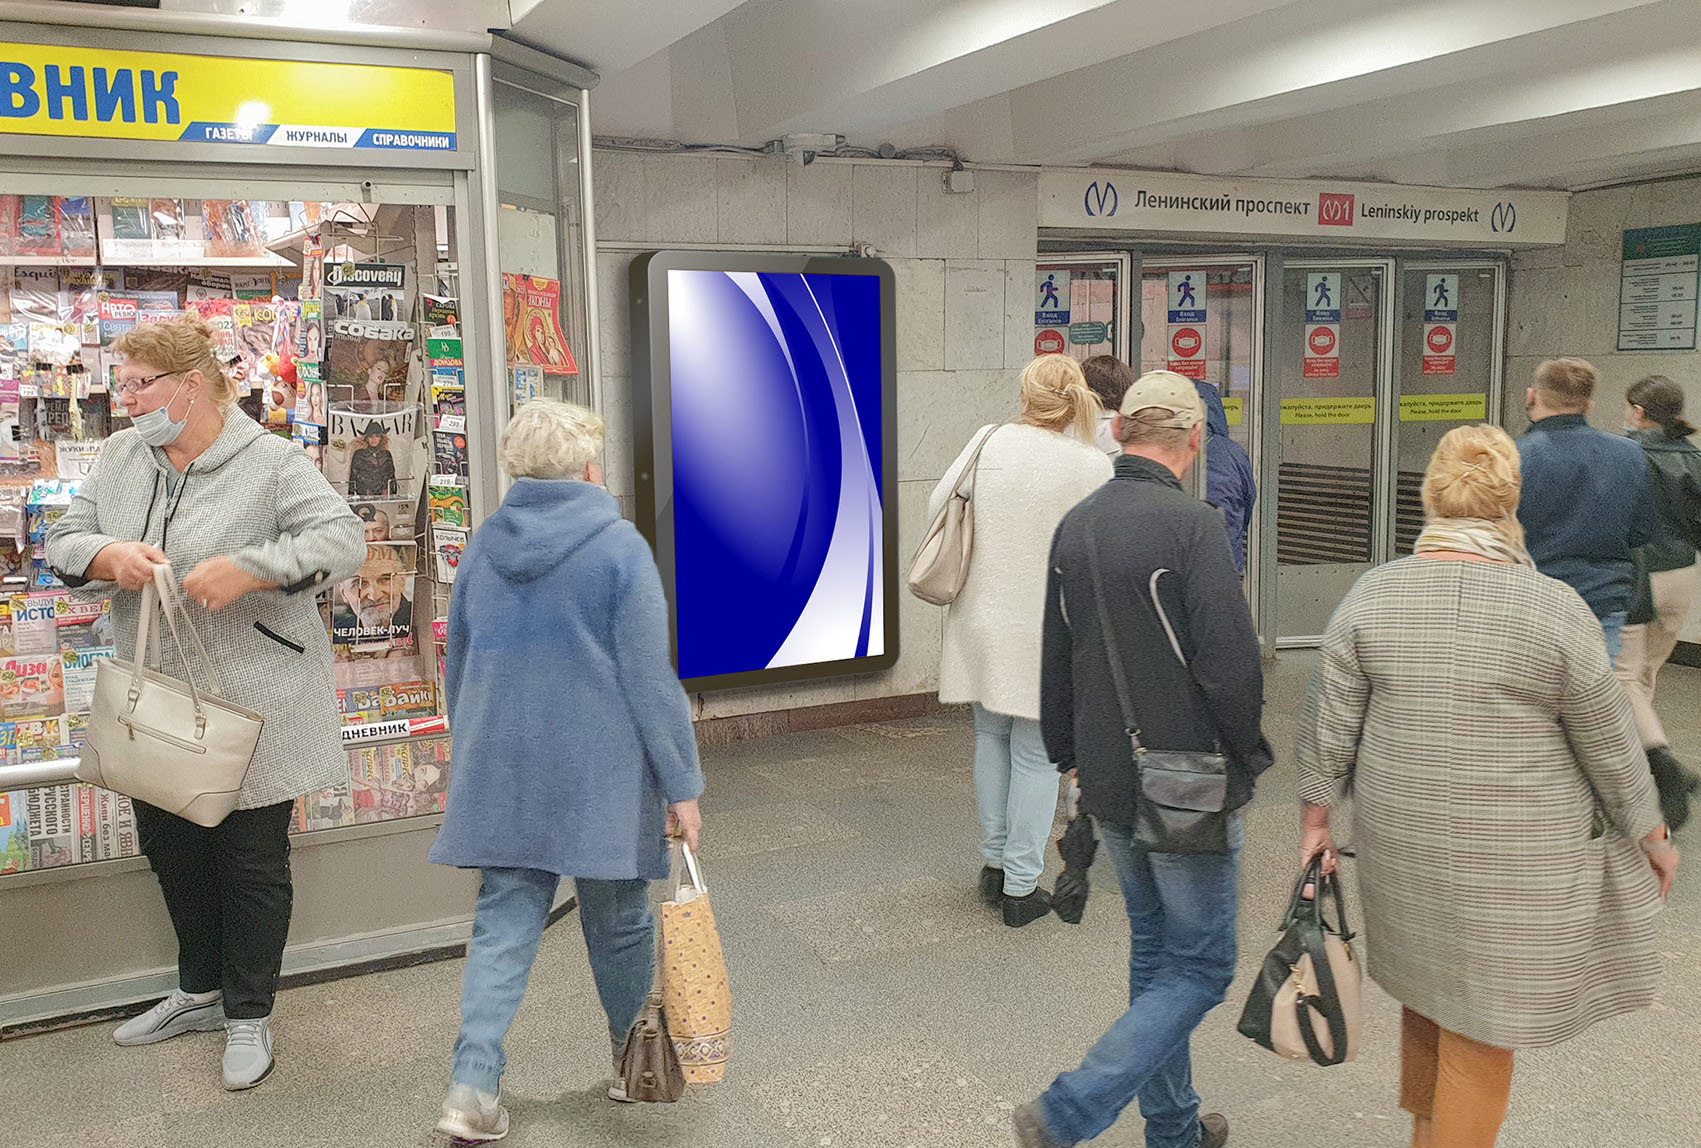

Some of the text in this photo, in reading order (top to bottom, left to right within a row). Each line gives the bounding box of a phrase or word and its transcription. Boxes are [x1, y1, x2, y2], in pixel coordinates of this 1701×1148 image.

[286, 130, 347, 144] ЖУРНАЛЫ
[372, 132, 449, 149] СПРАВОЧНИКИ
[1134, 190, 1311, 217] Ленинский проспект
[1361, 202, 1479, 225] Leninskiy prospekt
[333, 624, 410, 637] ЧЕЛОВЕК-ЛУЧ
[341, 722, 408, 741] ДНЕВНИК
